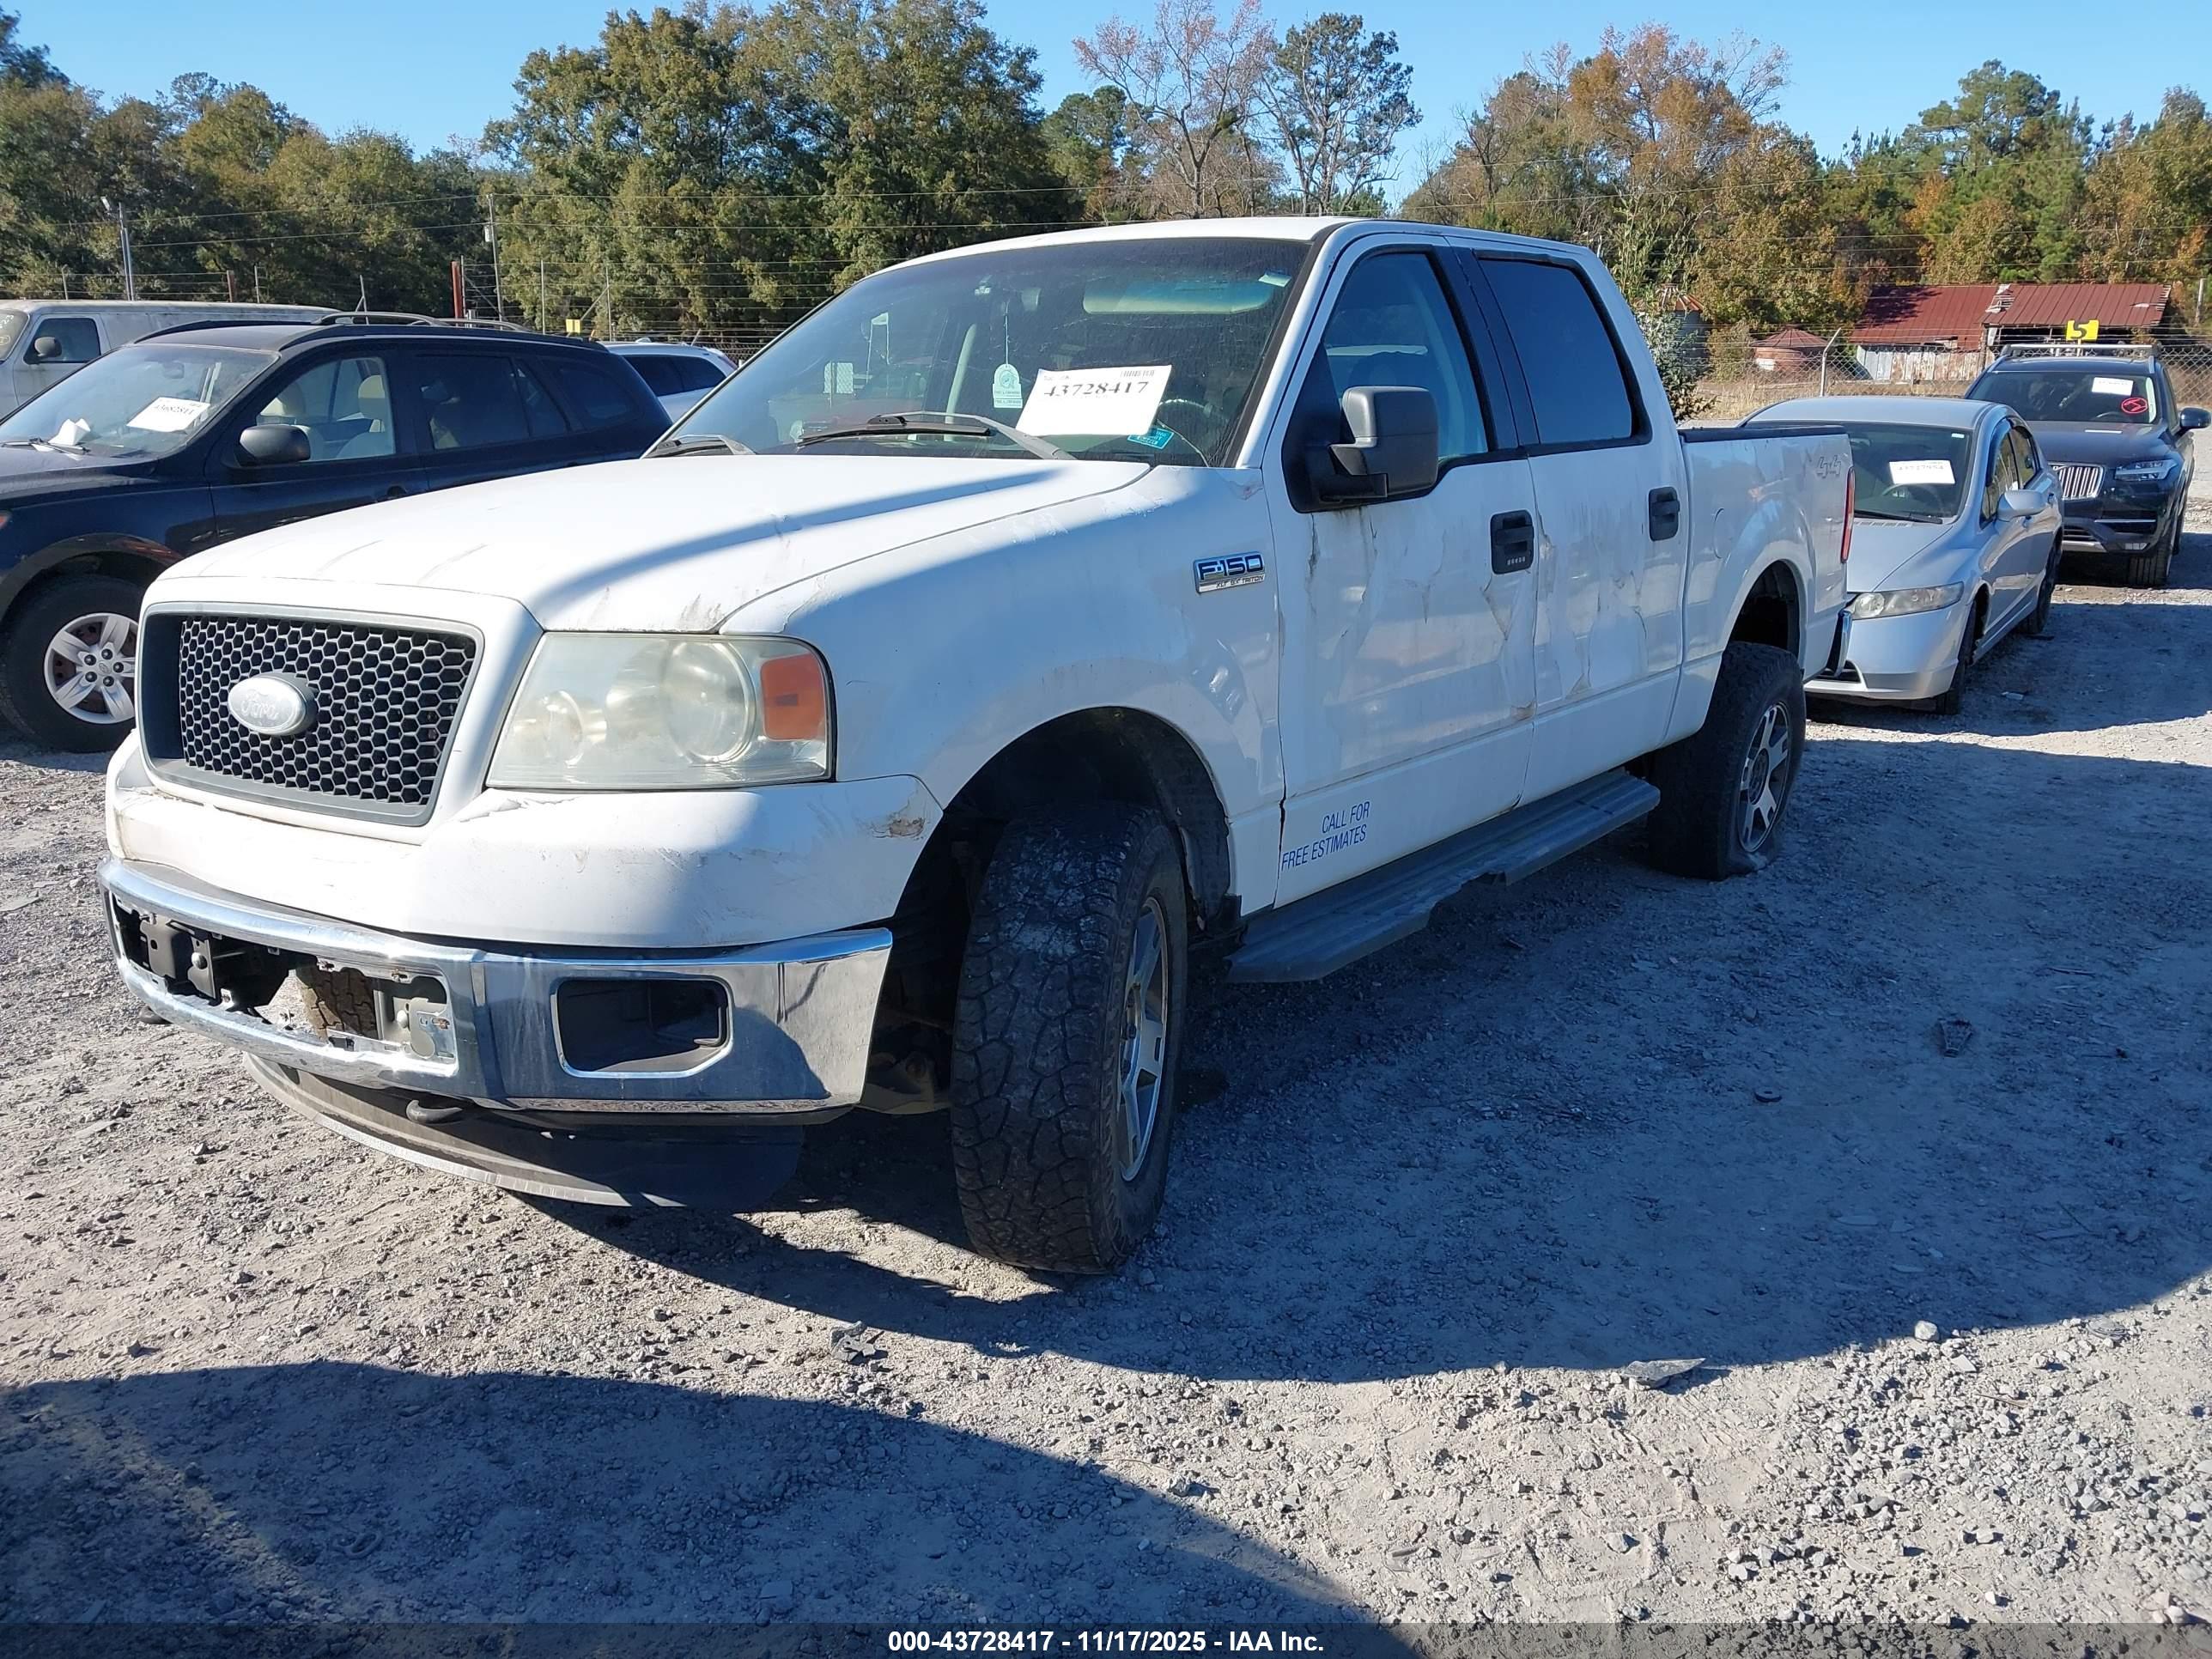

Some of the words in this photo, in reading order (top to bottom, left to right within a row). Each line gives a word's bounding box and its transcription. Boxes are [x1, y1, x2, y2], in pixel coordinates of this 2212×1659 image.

[2069, 319, 2090, 338] 5
[1043, 380, 1150, 398] 43728417
[1322, 811, 1347, 834] CALL
[1350, 801, 1370, 823] FOR
[1281, 845, 1310, 872] FREE
[1311, 823, 1367, 860] ESTIMATES
